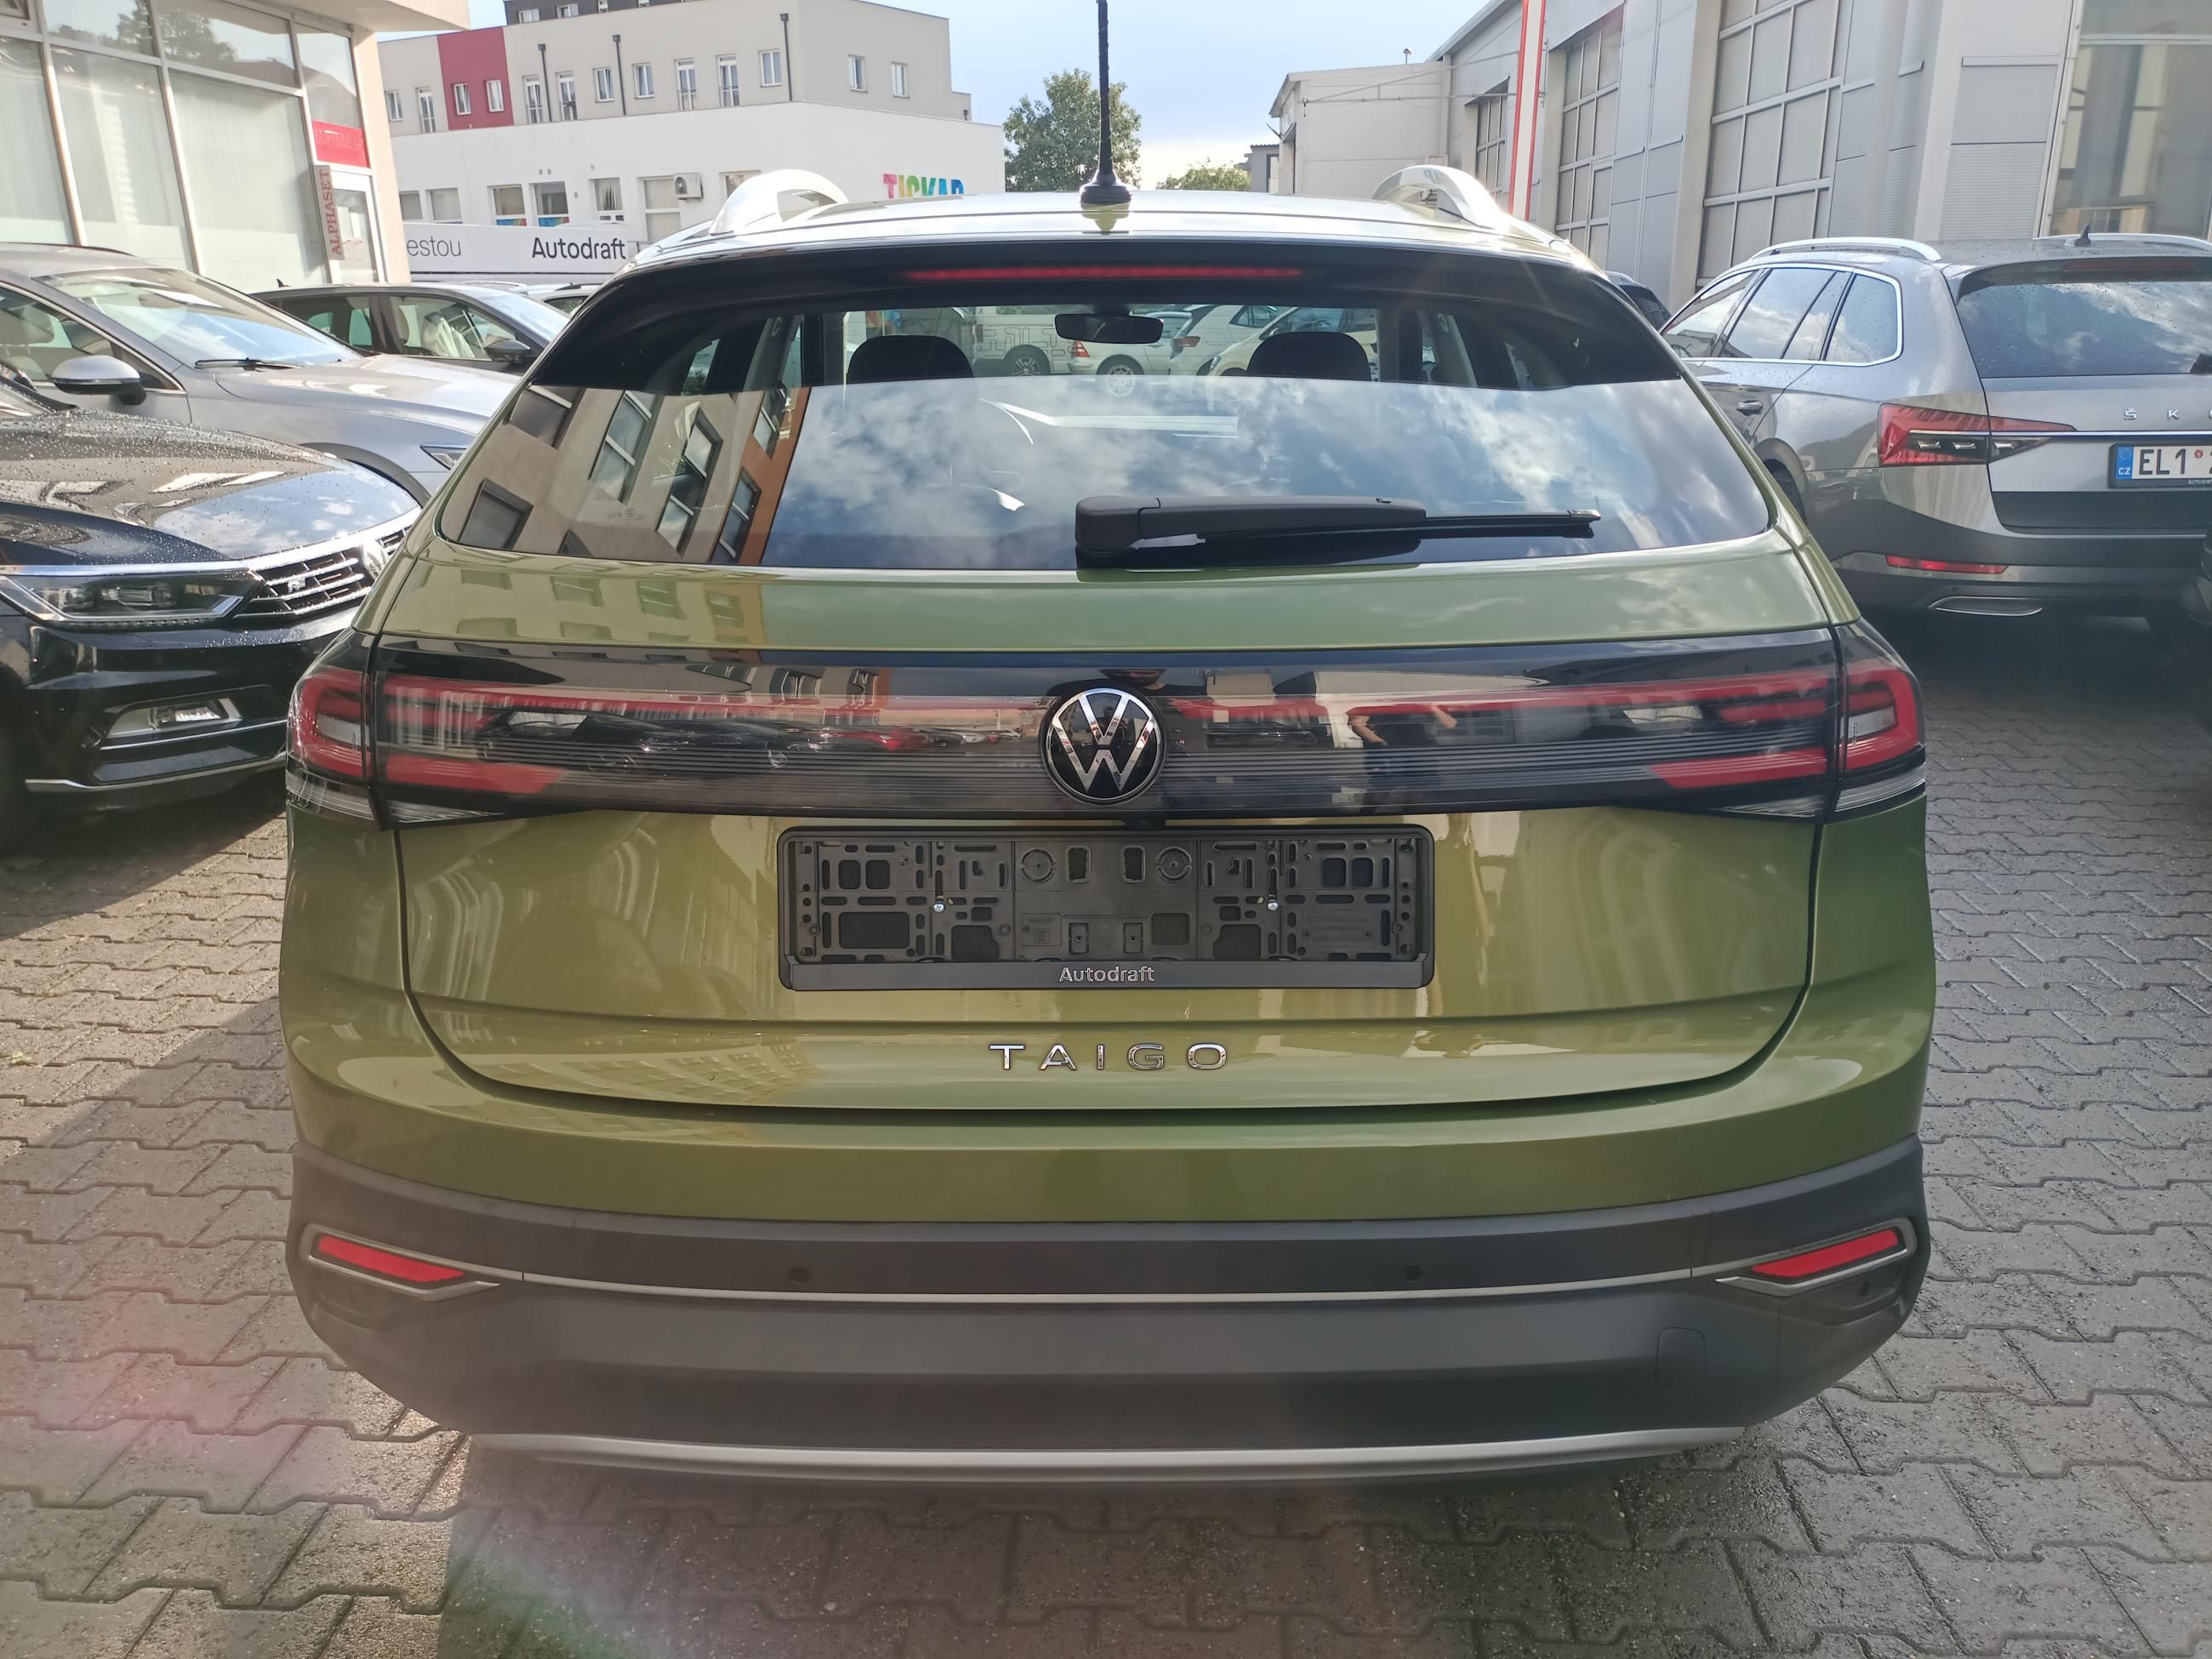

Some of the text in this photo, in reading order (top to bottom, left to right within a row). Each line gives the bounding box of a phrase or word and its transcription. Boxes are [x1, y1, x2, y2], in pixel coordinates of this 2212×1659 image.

[319, 169, 342, 256] ALPHASET
[532, 237, 626, 259] Autodraft
[2118, 466, 2131, 476] CZ
[1059, 966, 1155, 983] Autodraft
[989, 1043, 1228, 1071] TAIGO
